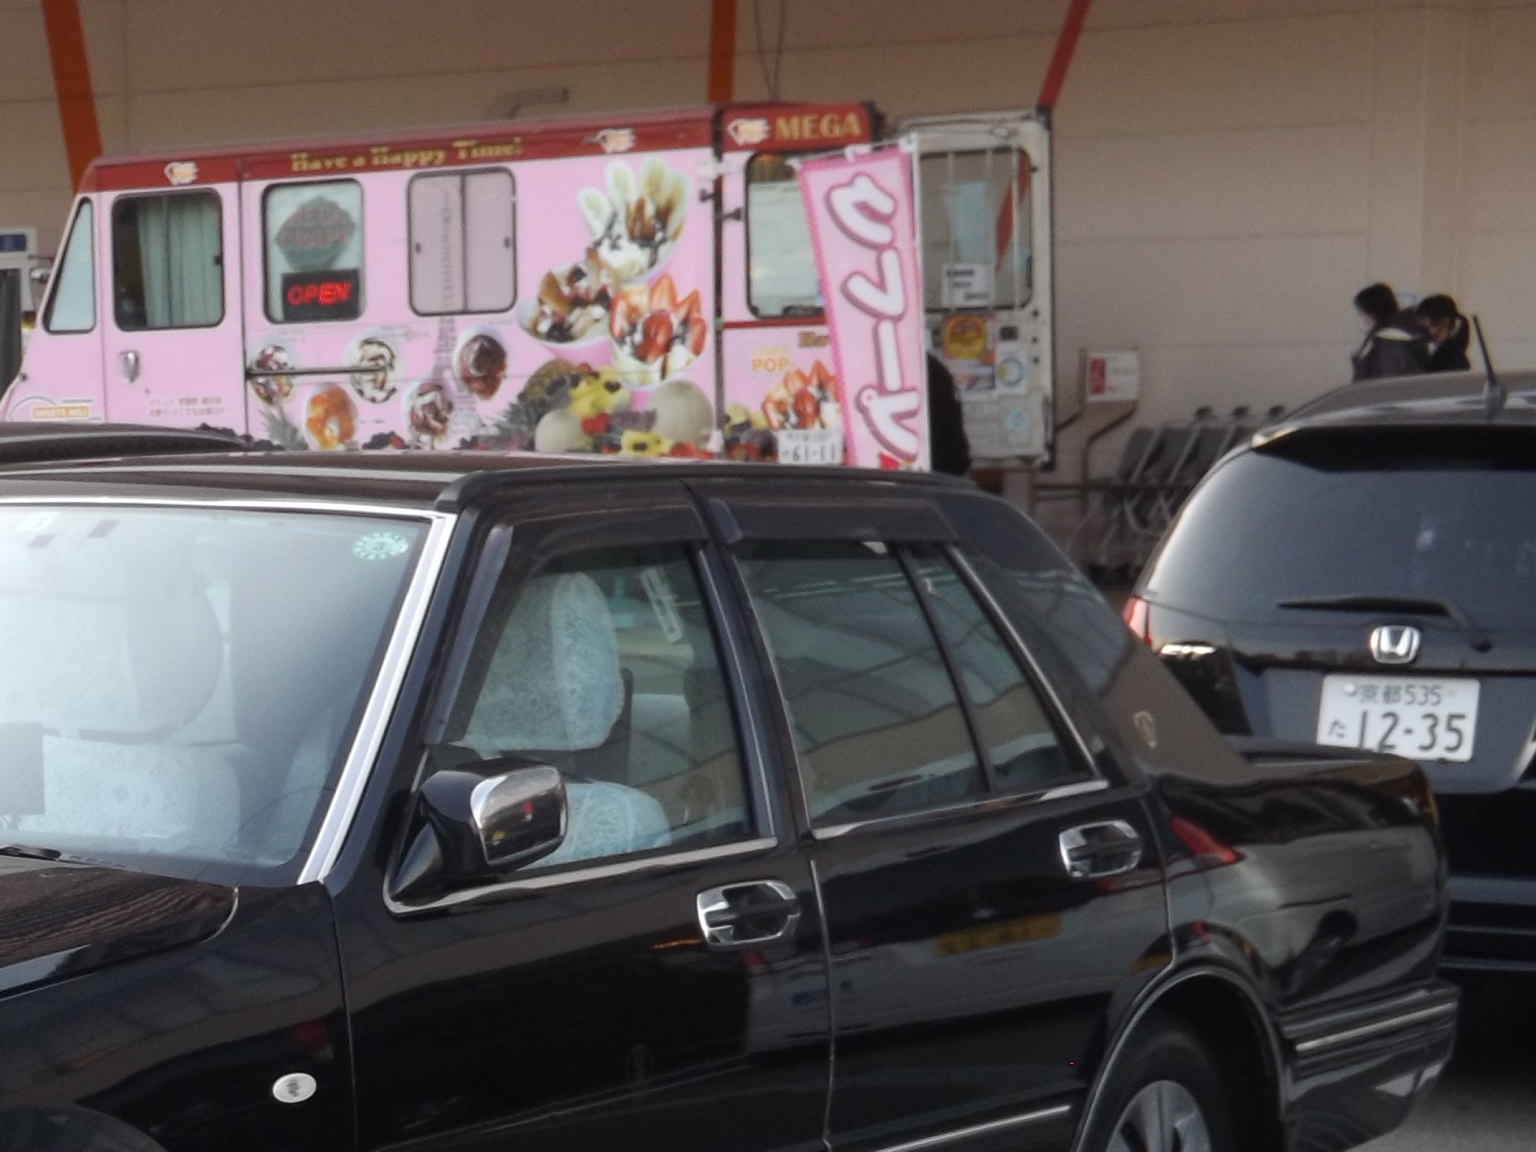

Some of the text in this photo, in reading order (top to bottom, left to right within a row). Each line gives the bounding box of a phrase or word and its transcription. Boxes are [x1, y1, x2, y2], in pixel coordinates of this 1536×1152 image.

[775, 113, 862, 141] MEGA
[290, 153, 349, 172] Have
[352, 156, 366, 168] a
[371, 146, 447, 168] Happy
[287, 280, 352, 307] OPEN
[752, 357, 790, 373] POP
[1359, 684, 1443, 706] 京都535
[1358, 711, 1466, 754] 12-35
